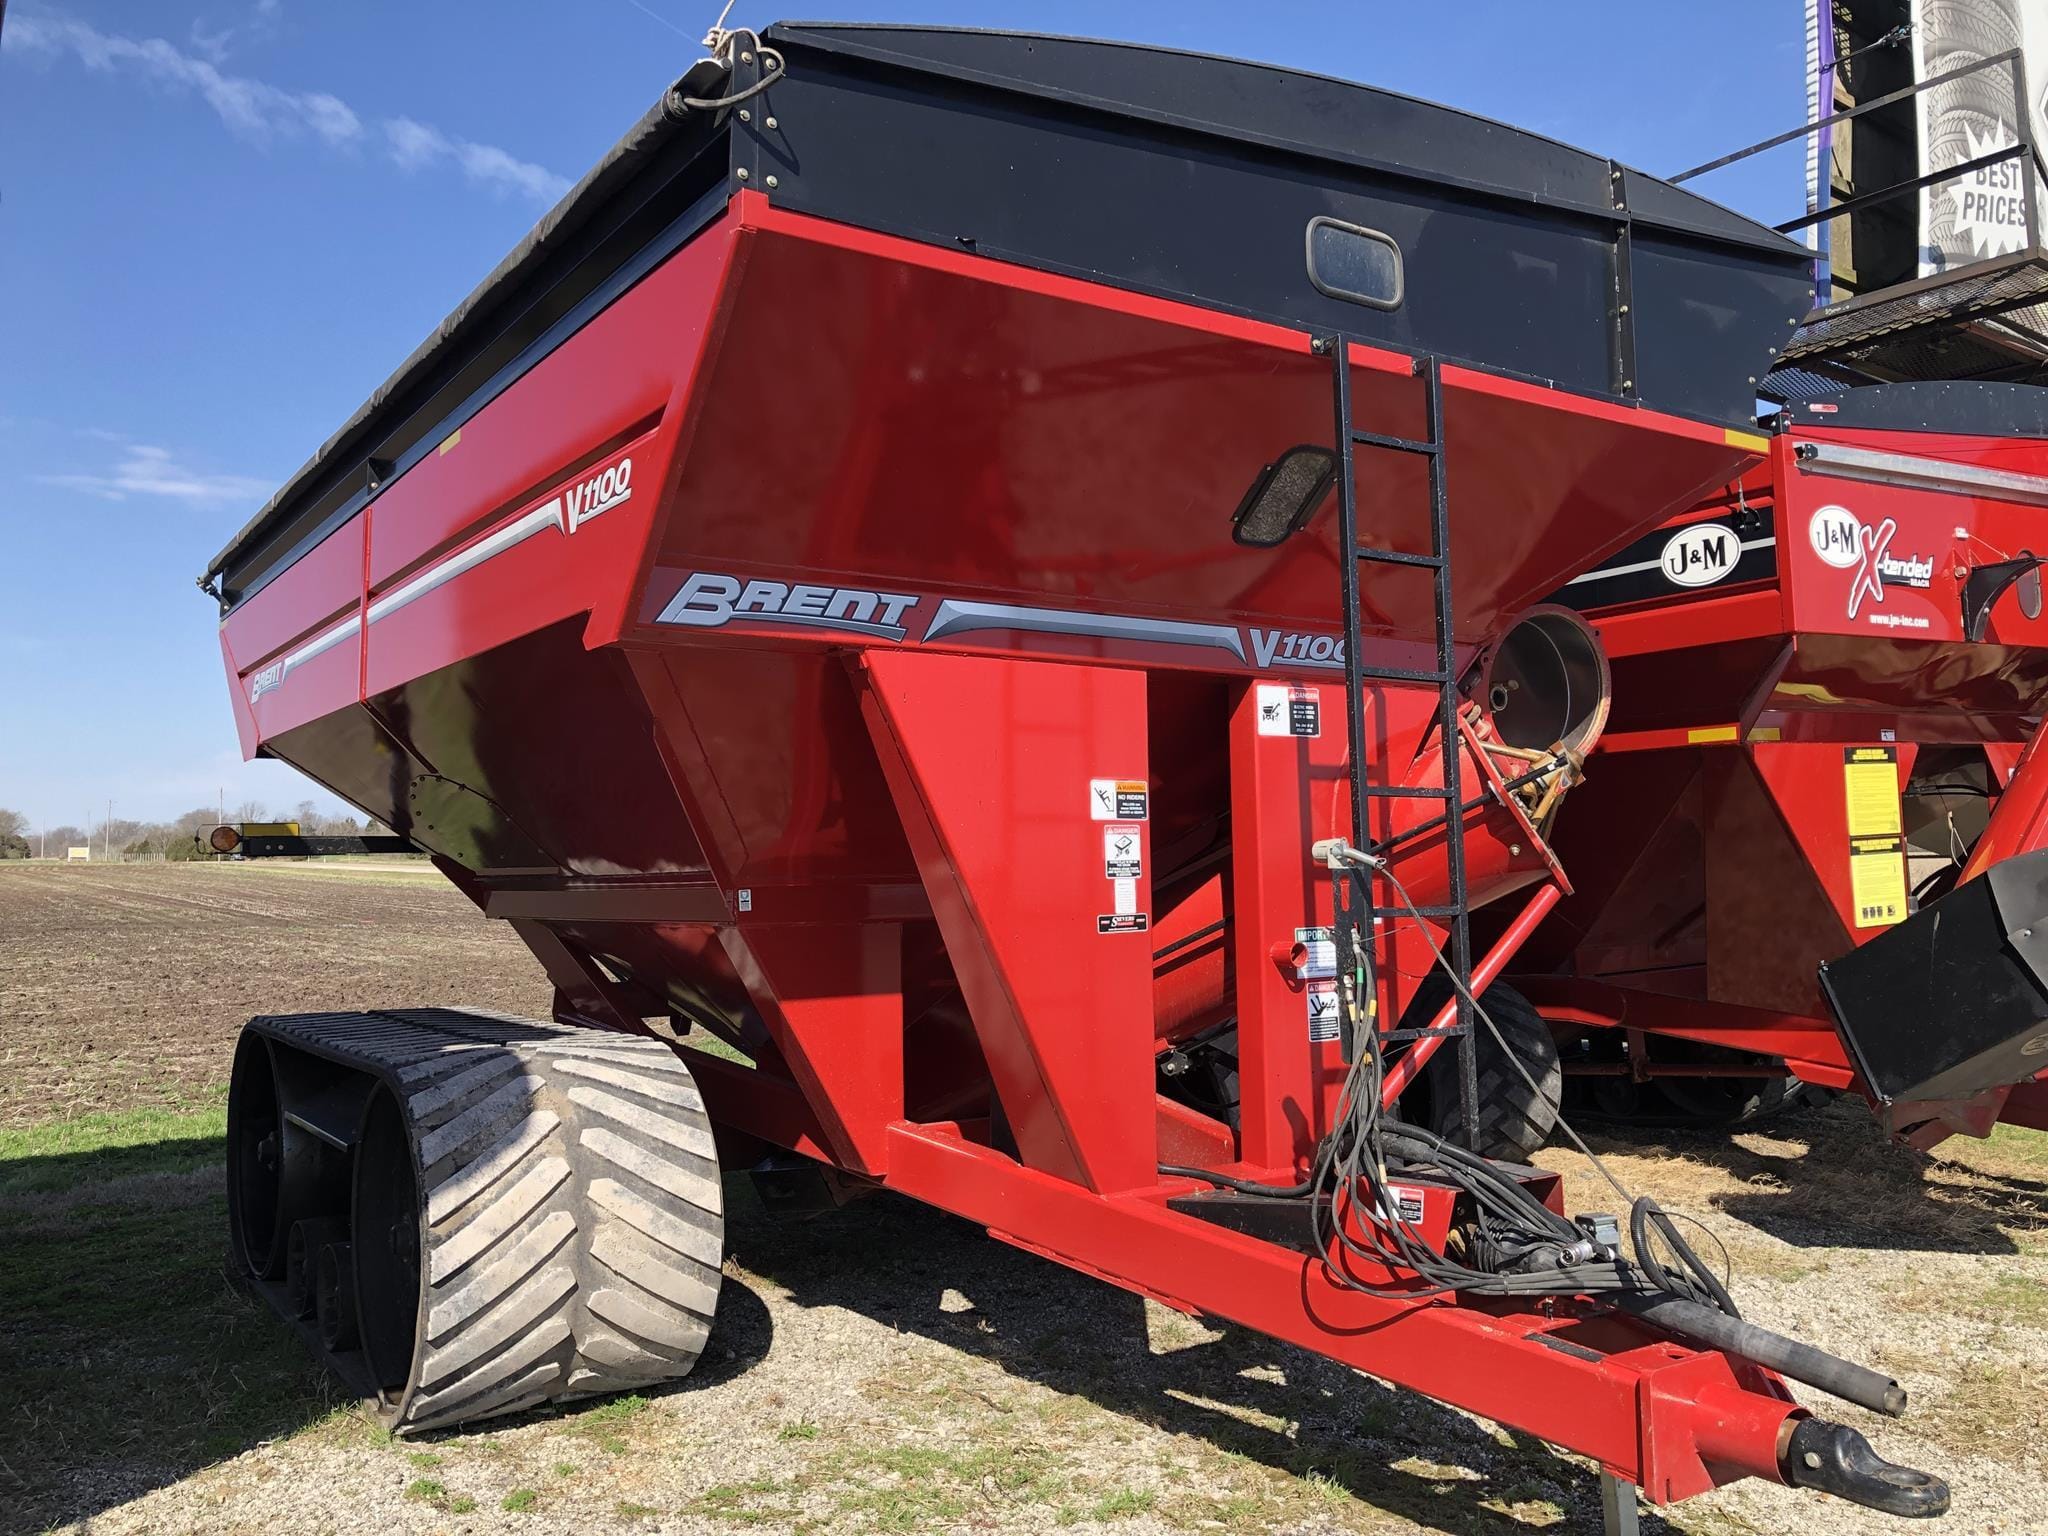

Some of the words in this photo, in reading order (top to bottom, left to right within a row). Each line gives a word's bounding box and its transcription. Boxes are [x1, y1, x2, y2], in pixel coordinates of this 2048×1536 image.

[1975, 162, 2019, 190] BEST
[1962, 191, 2026, 227] PRICES
[566, 458, 632, 535] V1100
[1669, 535, 1727, 576] J&M
[1817, 519, 1856, 554] J&M
[655, 572, 920, 628] BRENT
[250, 660, 282, 704] BRENT
